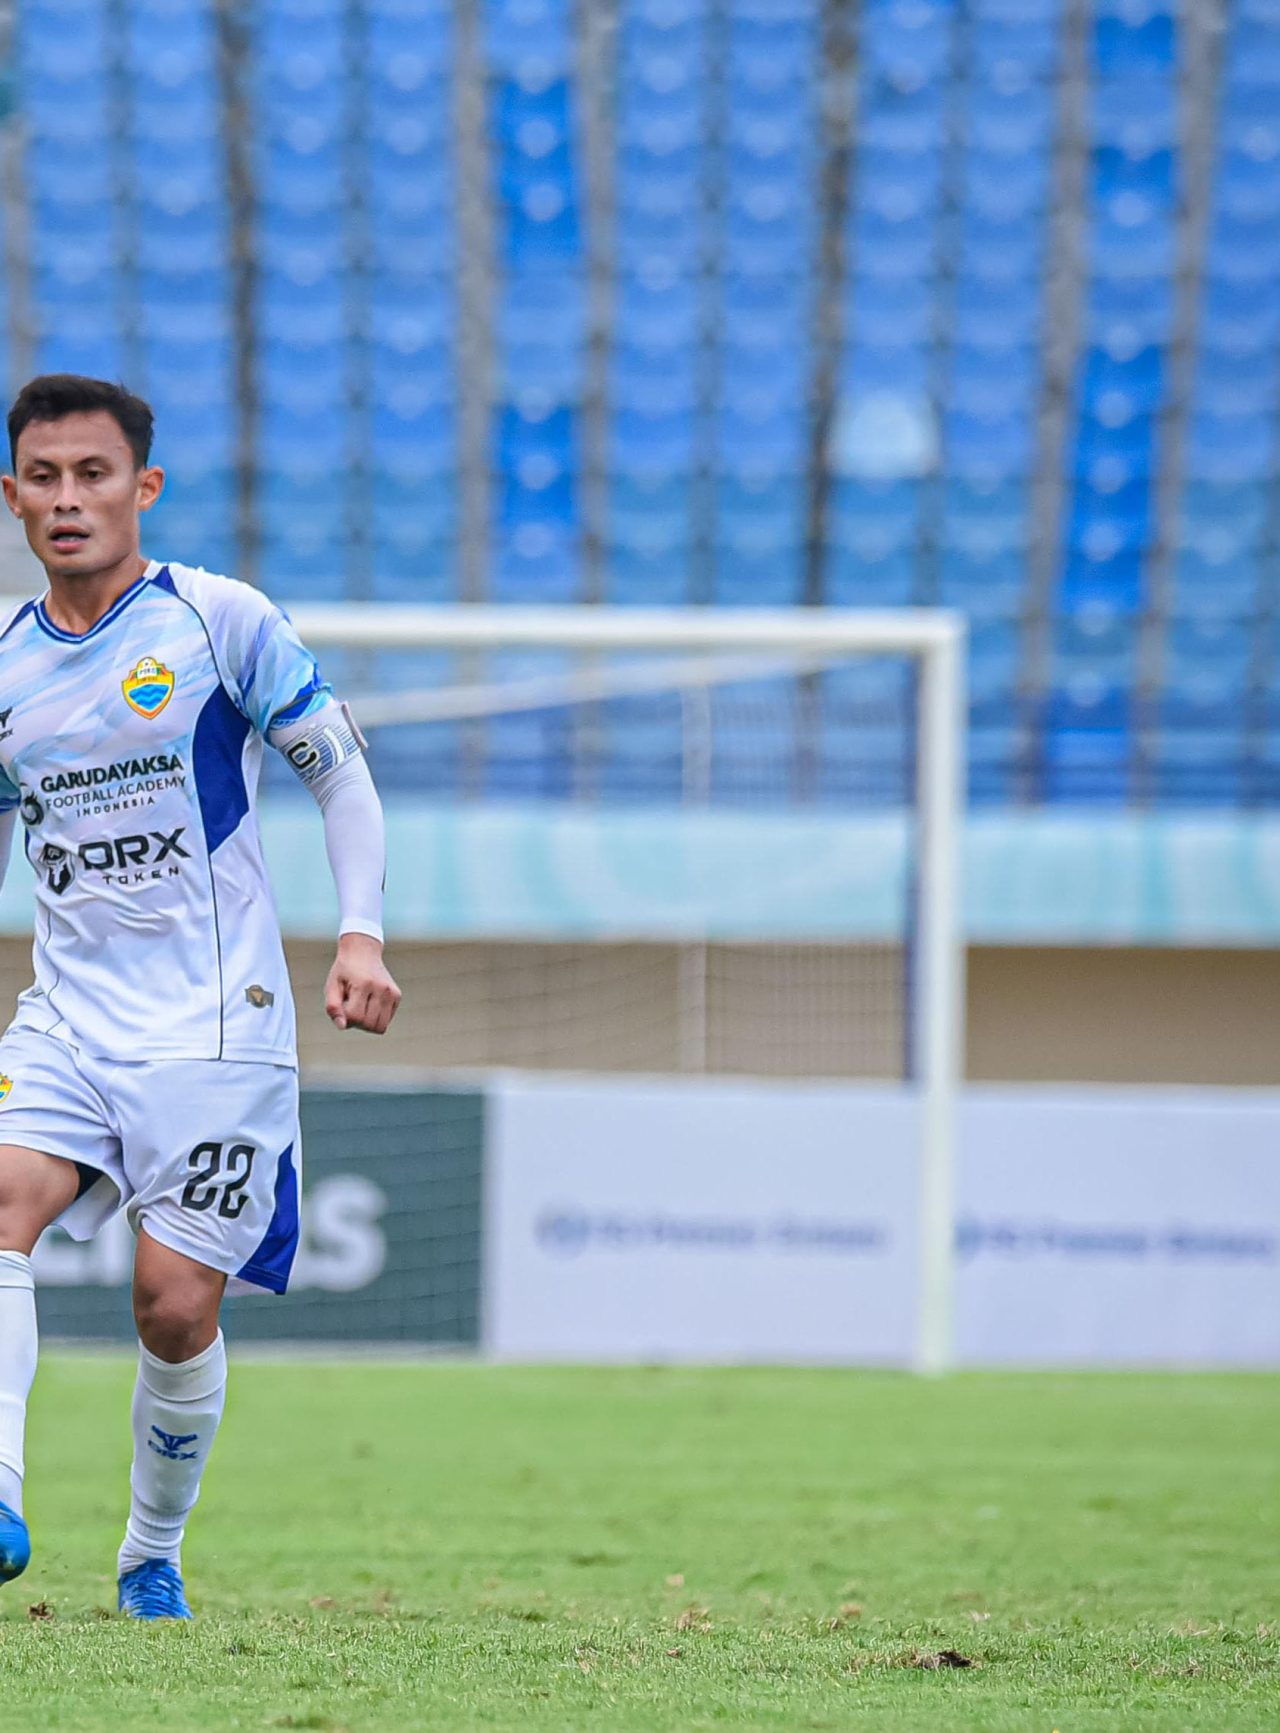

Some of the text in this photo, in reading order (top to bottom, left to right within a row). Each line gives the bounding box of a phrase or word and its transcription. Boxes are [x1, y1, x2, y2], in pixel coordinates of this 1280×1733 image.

[287, 741, 318, 770] C
[40, 754, 184, 793] GARUDAYAKSA
[46, 776, 186, 810] FOOTBALL ACADEMY
[76, 796, 156, 818] INDONESIA
[102, 866, 180, 885] TOKEN
[181, 1142, 256, 1219] 22
